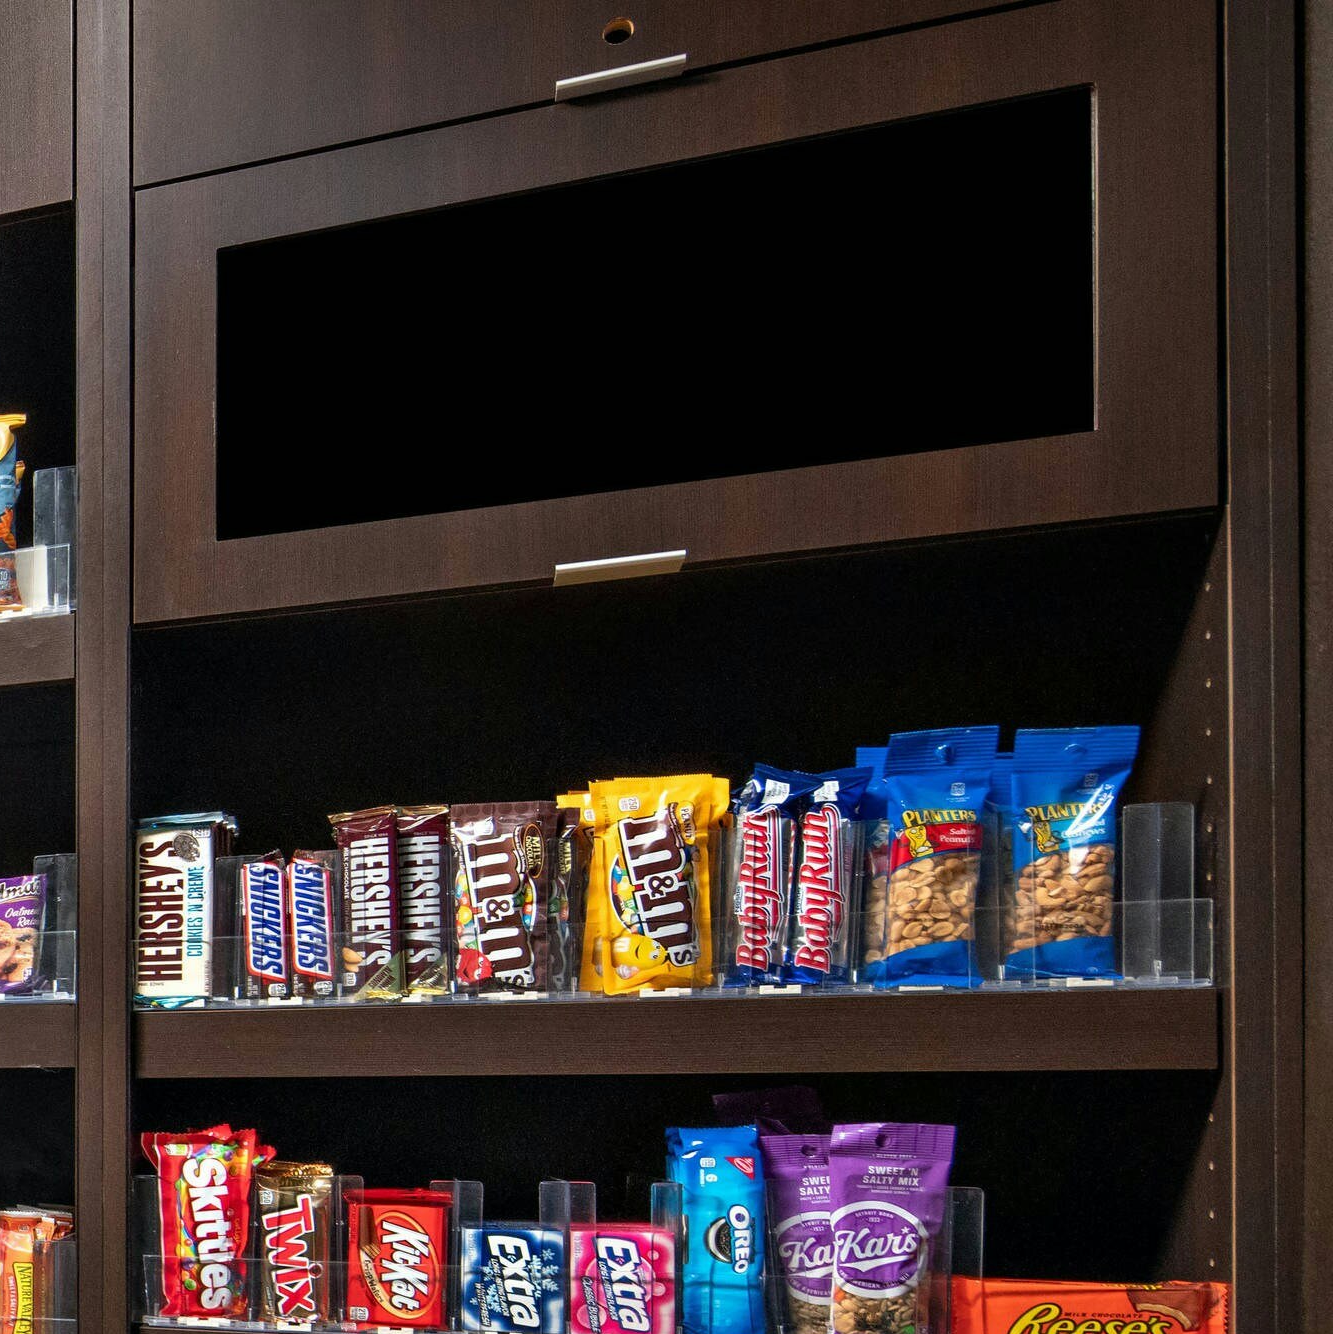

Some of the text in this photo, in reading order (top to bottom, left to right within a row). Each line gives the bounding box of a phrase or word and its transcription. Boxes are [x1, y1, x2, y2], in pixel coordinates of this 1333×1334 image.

[682, 805, 693, 840] PEANUT
[901, 809, 978, 828] PLANTERS
[138, 840, 183, 982] HERSHEY'S
[350, 836, 392, 968] HERSHEY'S
[862, 1175, 920, 1187] SALTY MIX
[868, 1165, 905, 1176] SWEET
[181, 1157, 236, 1311] Skittles
[262, 1194, 315, 1316] TWIX
[728, 1204, 751, 1275] OREO
[834, 1226, 918, 1263] Kar's
[488, 1235, 540, 1328] Extra
[596, 1236, 650, 1333] Extra
